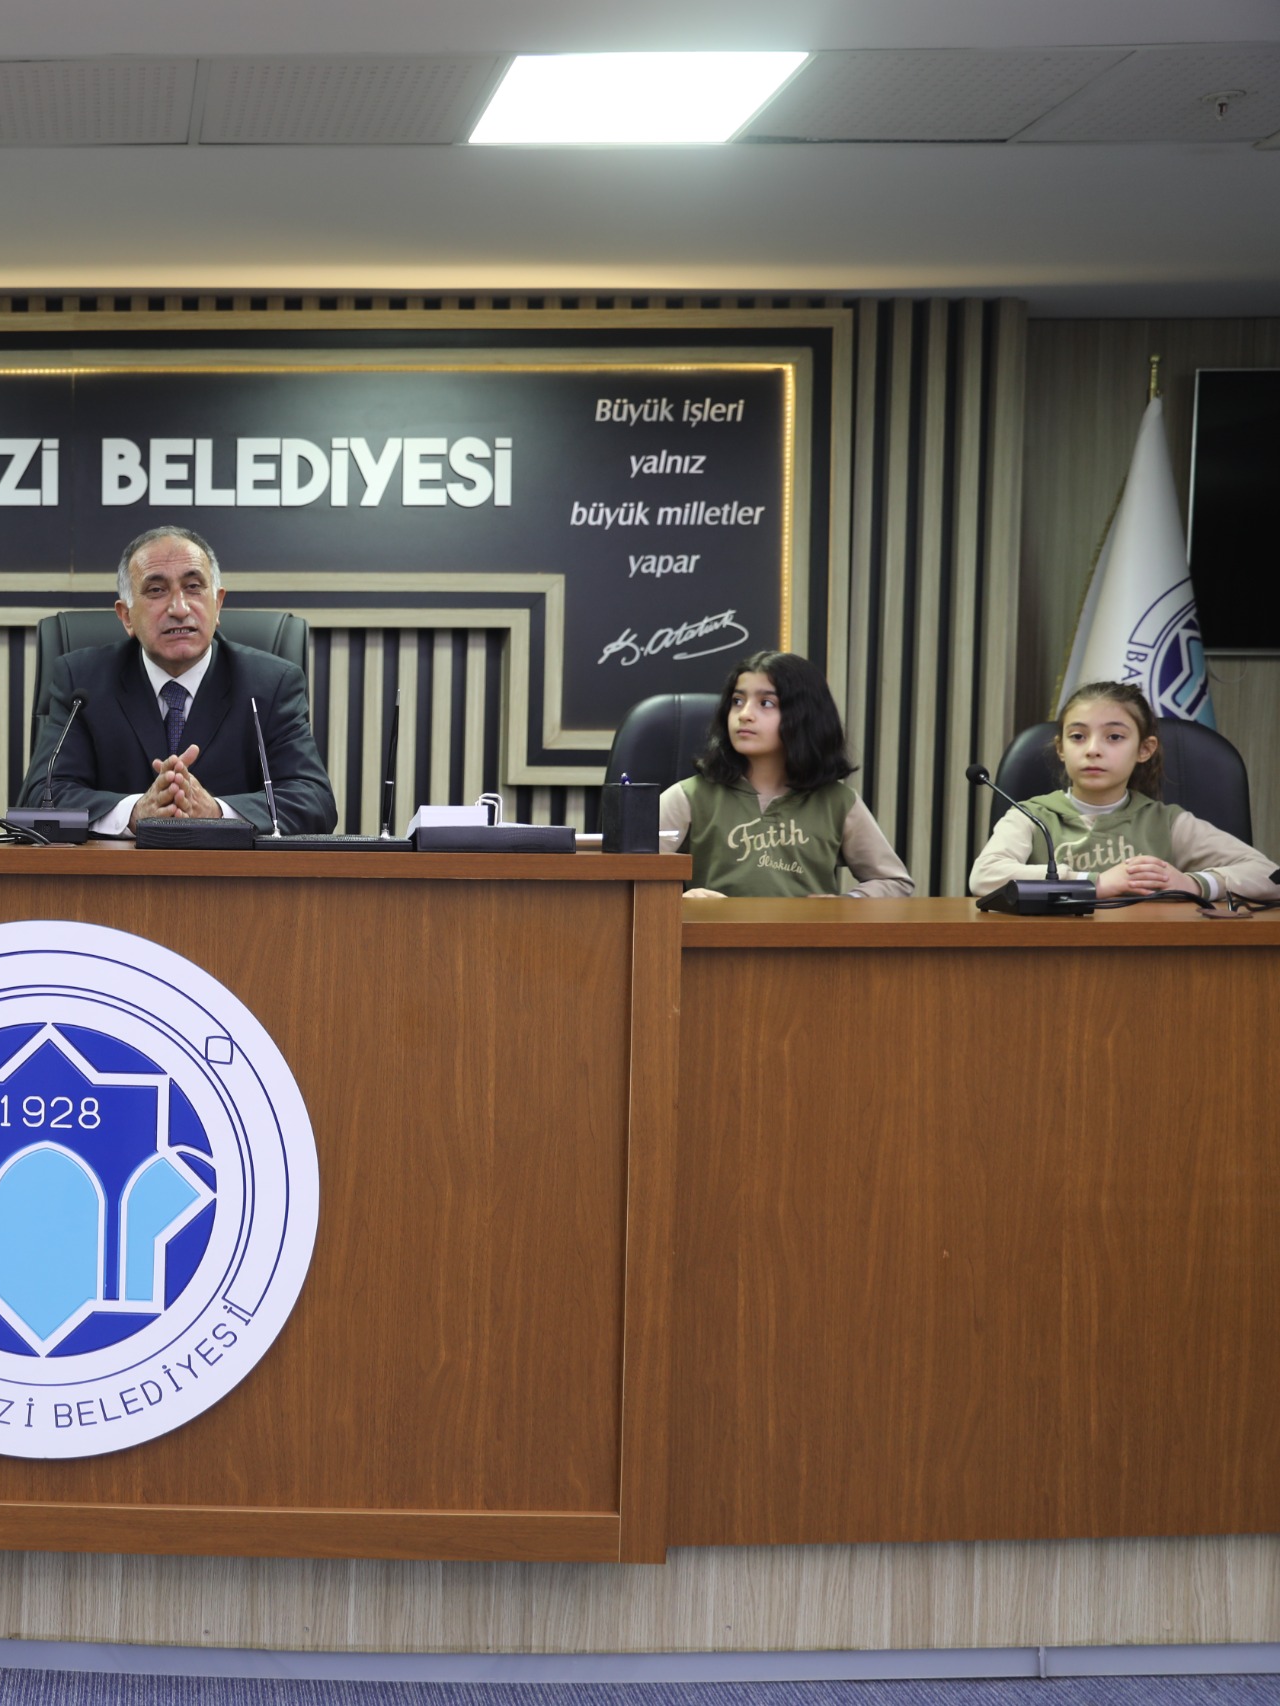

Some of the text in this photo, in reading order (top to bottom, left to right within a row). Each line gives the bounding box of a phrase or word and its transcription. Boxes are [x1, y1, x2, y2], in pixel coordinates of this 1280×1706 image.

[595, 398, 745, 428] Büyük işleri
[630, 450, 707, 478] yalnız
[570, 501, 765, 530] büyük milletler
[628, 554, 700, 578] yapar
[727, 817, 810, 862] Fatih
[0, 1094, 101, 1130] 1928
[53, 1304, 251, 1429] BELEDİYESİ
